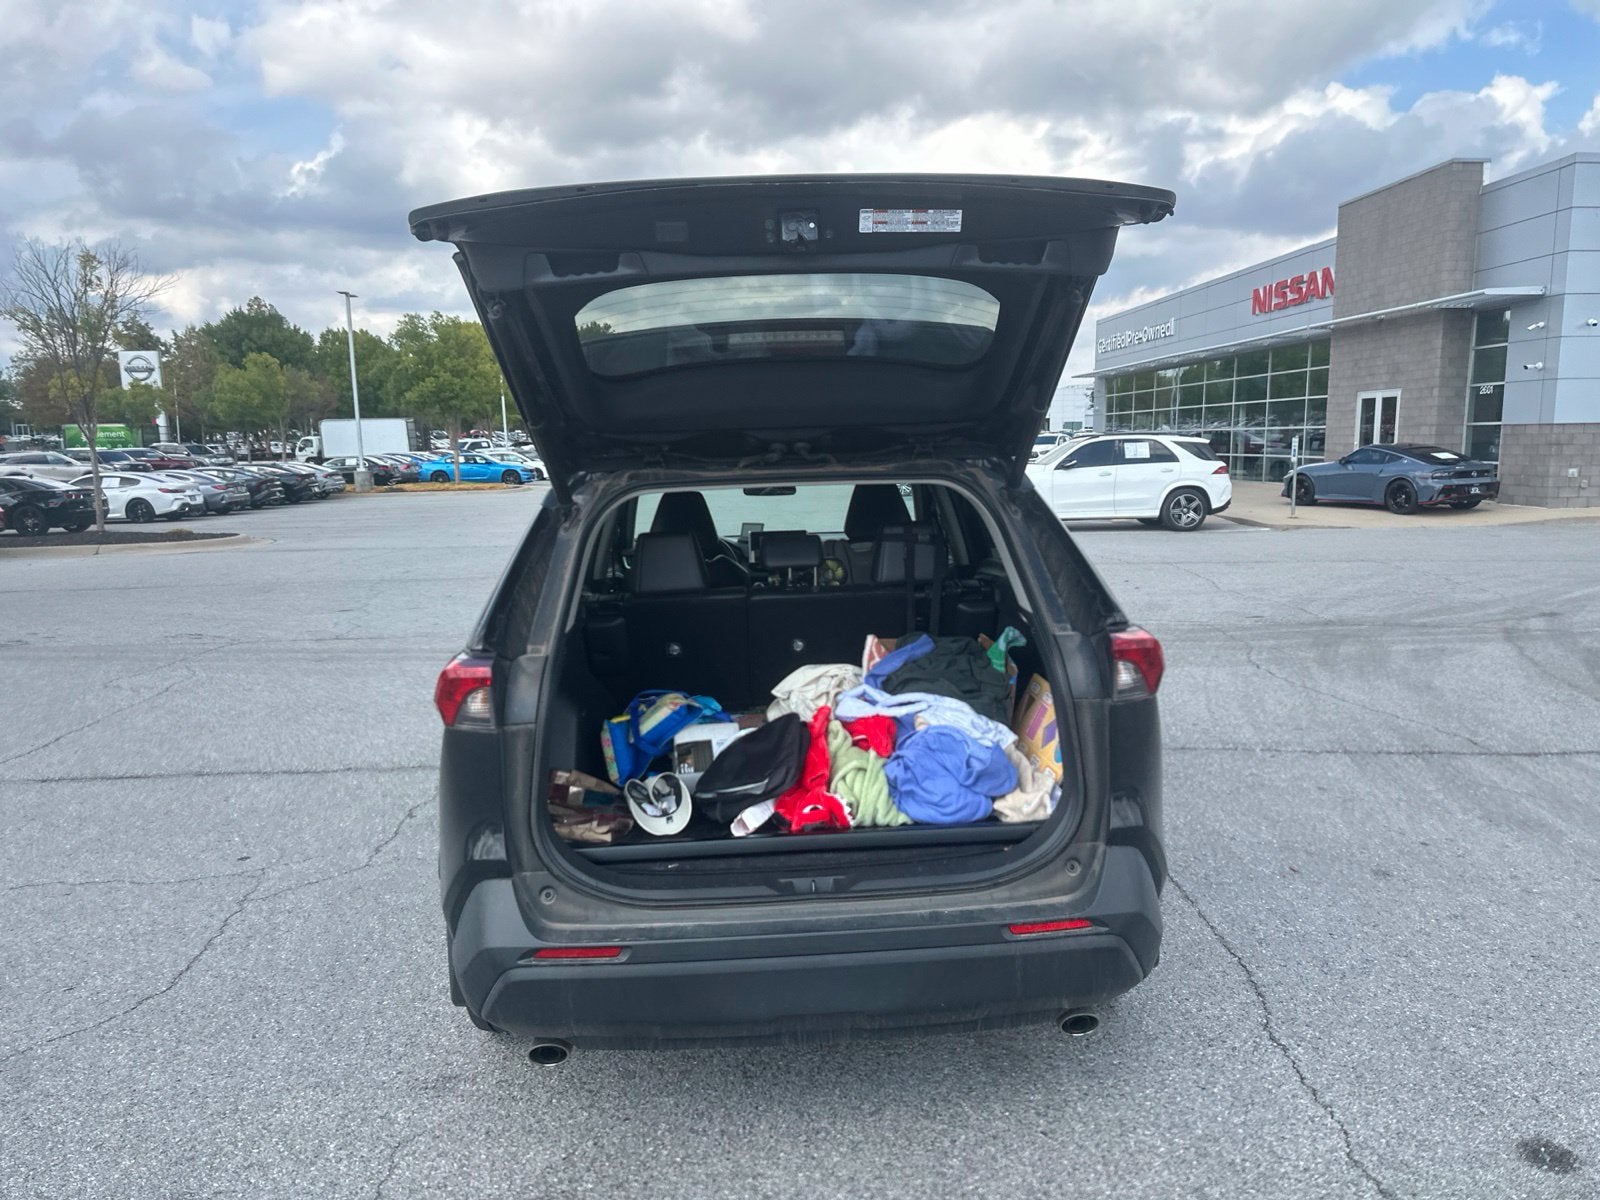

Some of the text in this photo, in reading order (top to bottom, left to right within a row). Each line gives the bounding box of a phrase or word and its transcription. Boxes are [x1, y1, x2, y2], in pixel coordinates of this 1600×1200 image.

[1252, 267, 1334, 315] NISSAN
[1097, 317, 1174, 353] Certified Pre-Owned
[96, 430, 125, 438] lement
